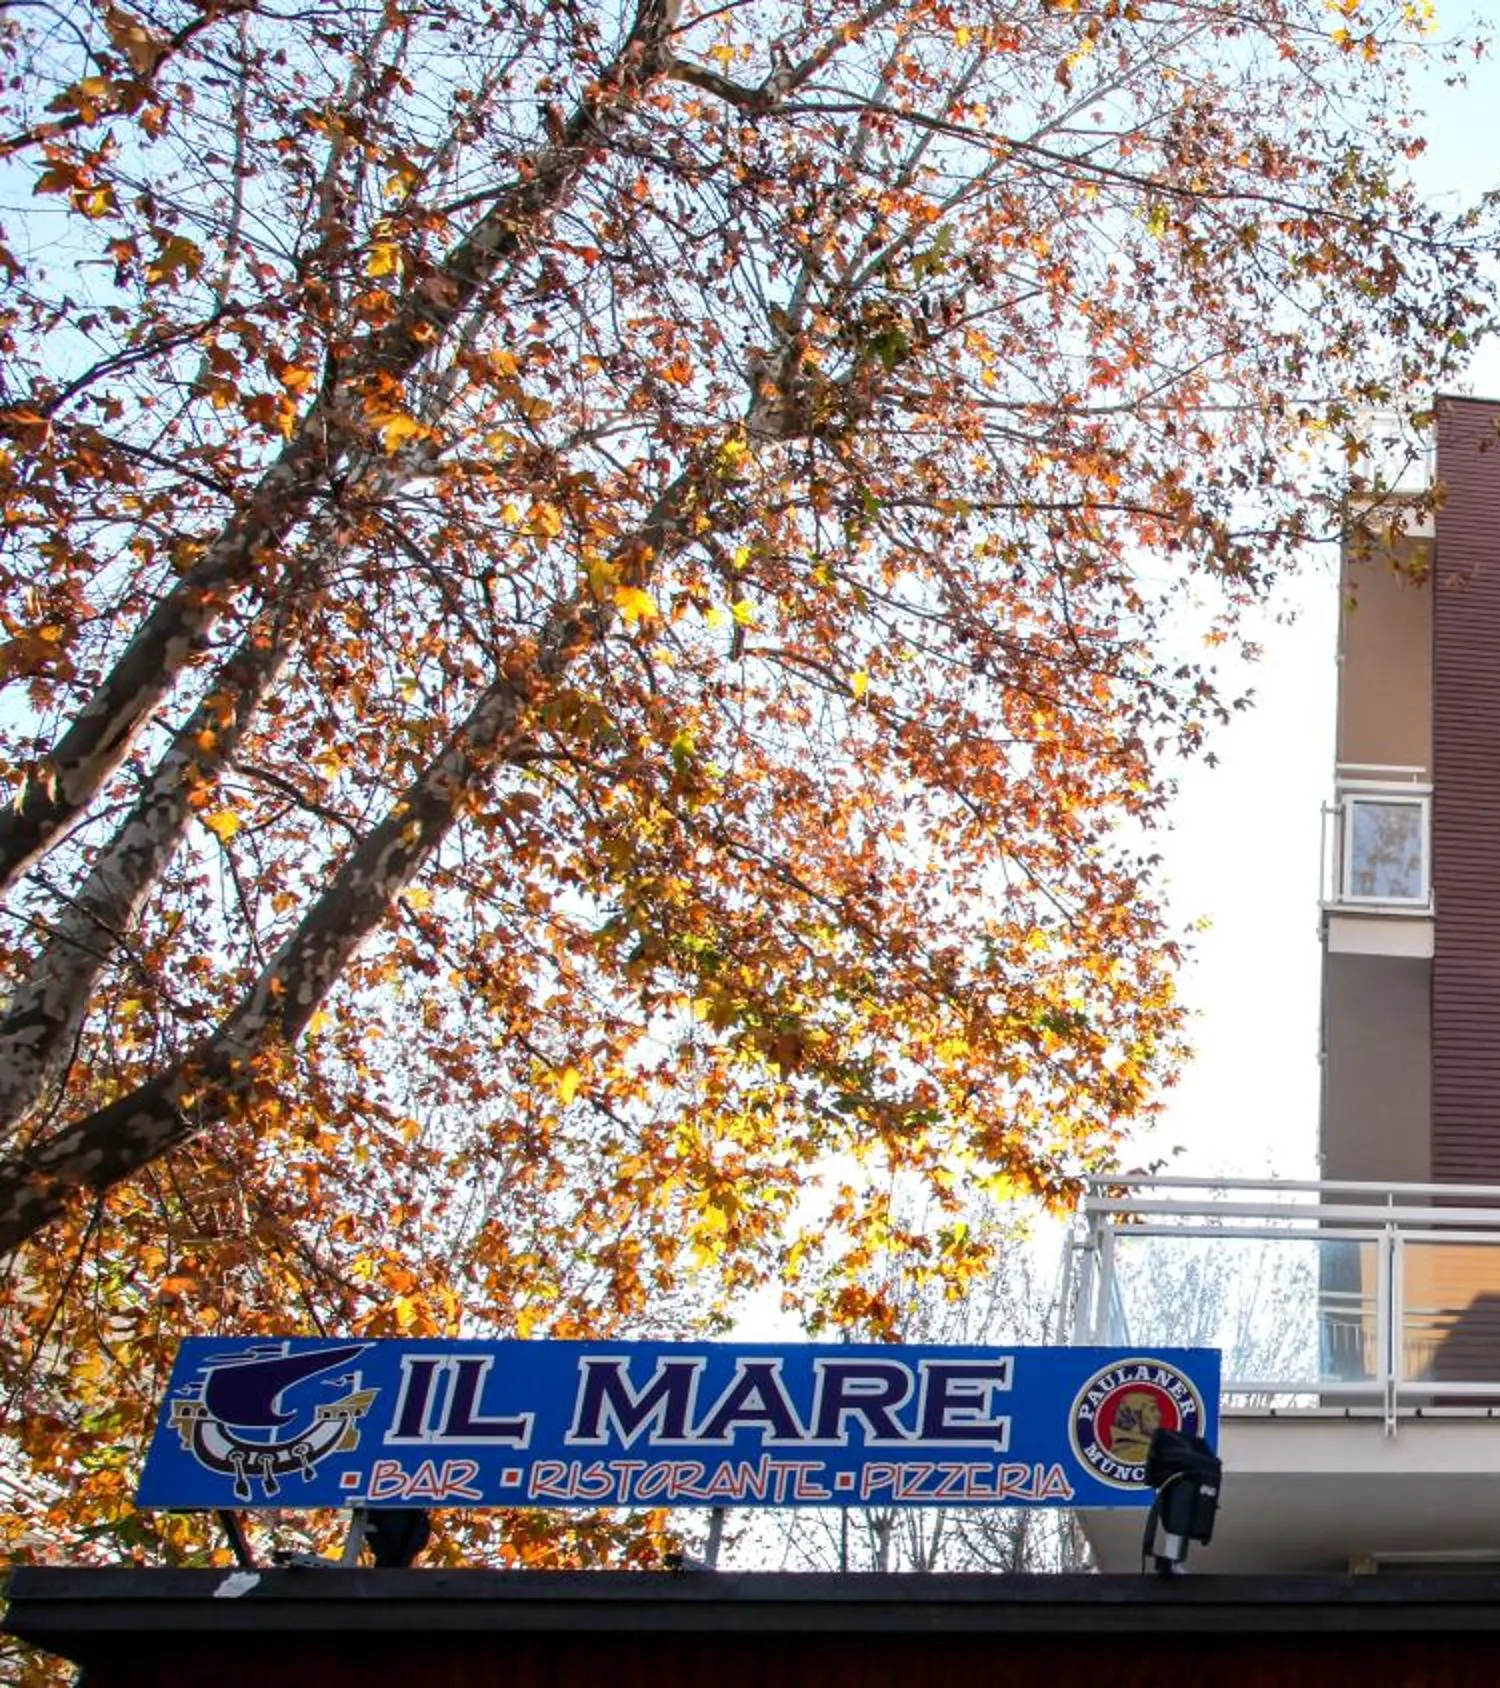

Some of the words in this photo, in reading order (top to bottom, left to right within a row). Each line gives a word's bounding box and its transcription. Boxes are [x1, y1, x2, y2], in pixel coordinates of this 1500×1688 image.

[384, 1354, 536, 1450] IL
[564, 1355, 1015, 1453] MARE
[1078, 1366, 1197, 1421] PAULANER
[367, 1458, 484, 1500] BAR
[528, 1455, 832, 1502] RISTORANTE
[860, 1461, 1075, 1502] PIZZERIA
